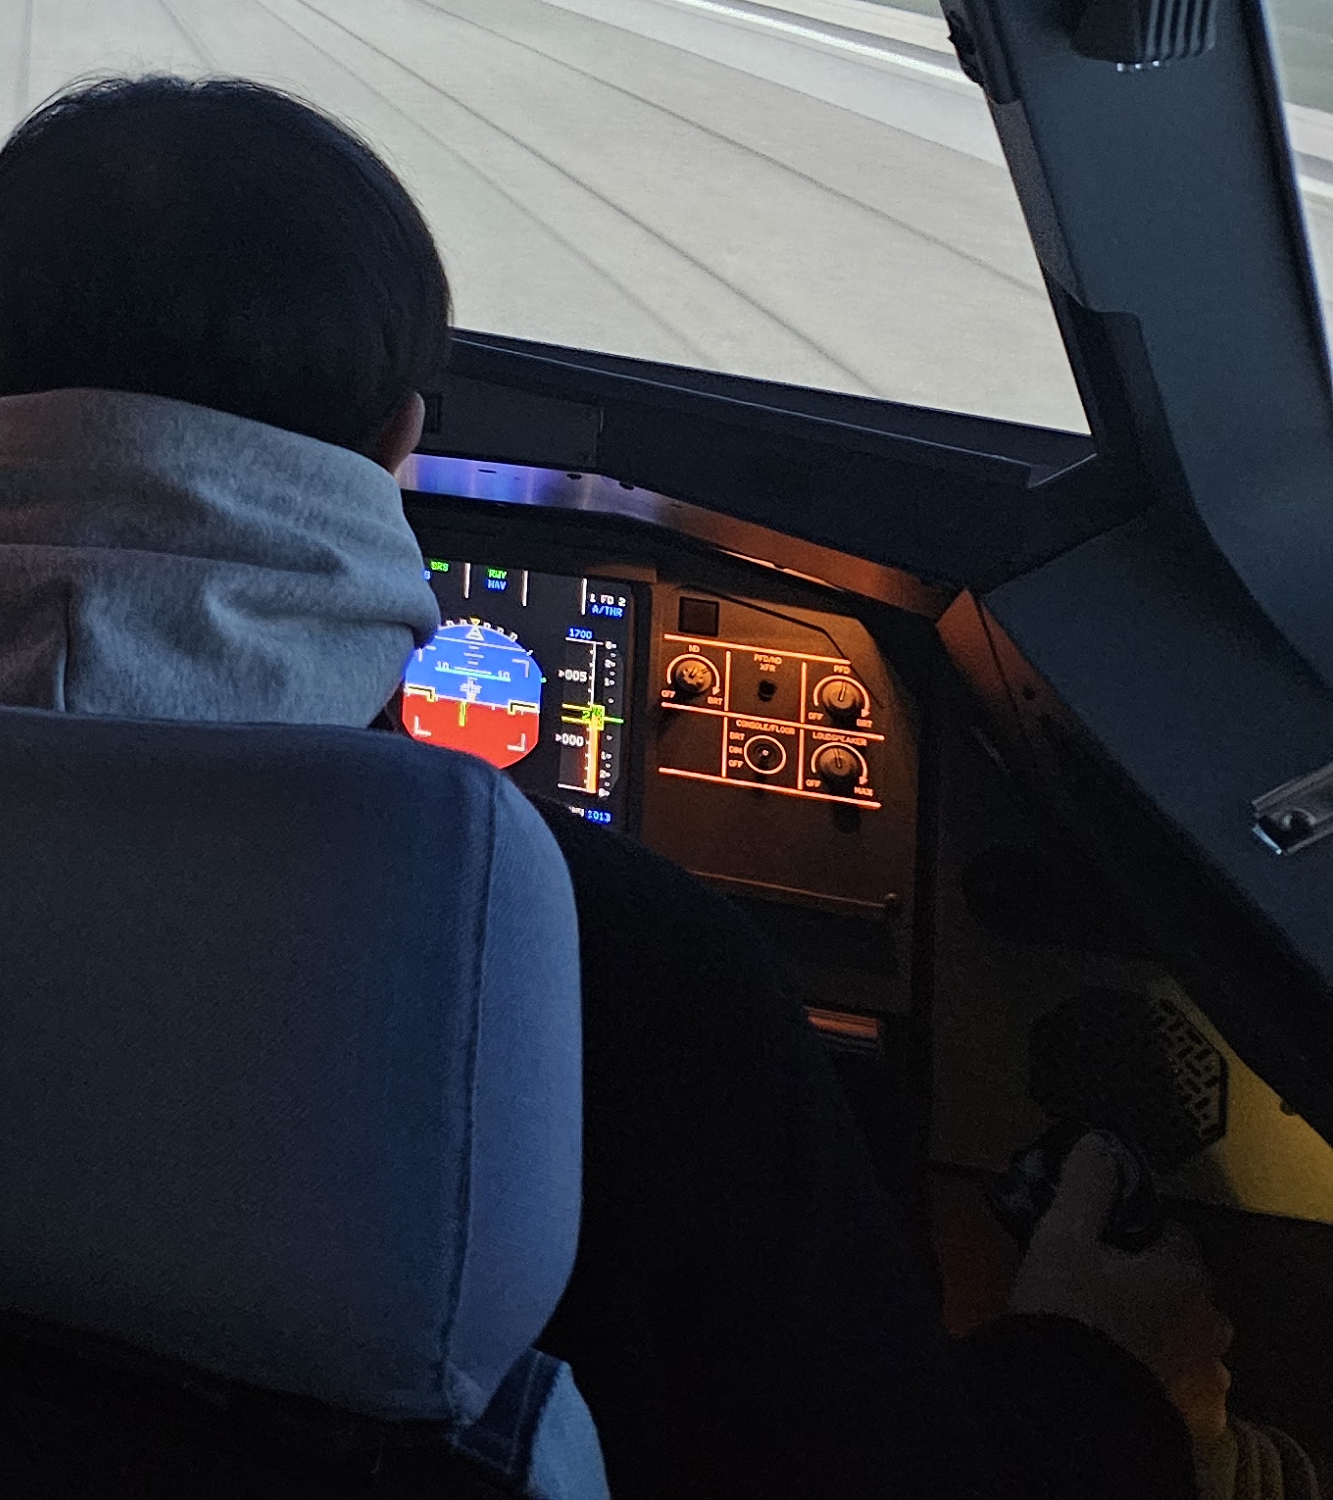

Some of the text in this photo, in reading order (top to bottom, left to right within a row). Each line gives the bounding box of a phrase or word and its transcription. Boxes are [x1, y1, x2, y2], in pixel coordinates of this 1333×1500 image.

[430, 561, 449, 572] SRS
[488, 568, 507, 579] RWY
[487, 580, 507, 591] NAV
[600, 594, 614, 605] FD
[618, 597, 626, 607] 2
[591, 605, 623, 618] A/THR
[569, 628, 593, 639] 1700
[437, 660, 450, 670] 10
[833, 665, 851, 675] PFD
[497, 670, 511, 680] 10
[564, 669, 587, 682] 005
[735, 719, 796, 736] CONSOLE/FLOOR
[561, 733, 584, 746] 000
[811, 731, 868, 747] LOUDSPEAKER
[587, 809, 611, 823] 1013
